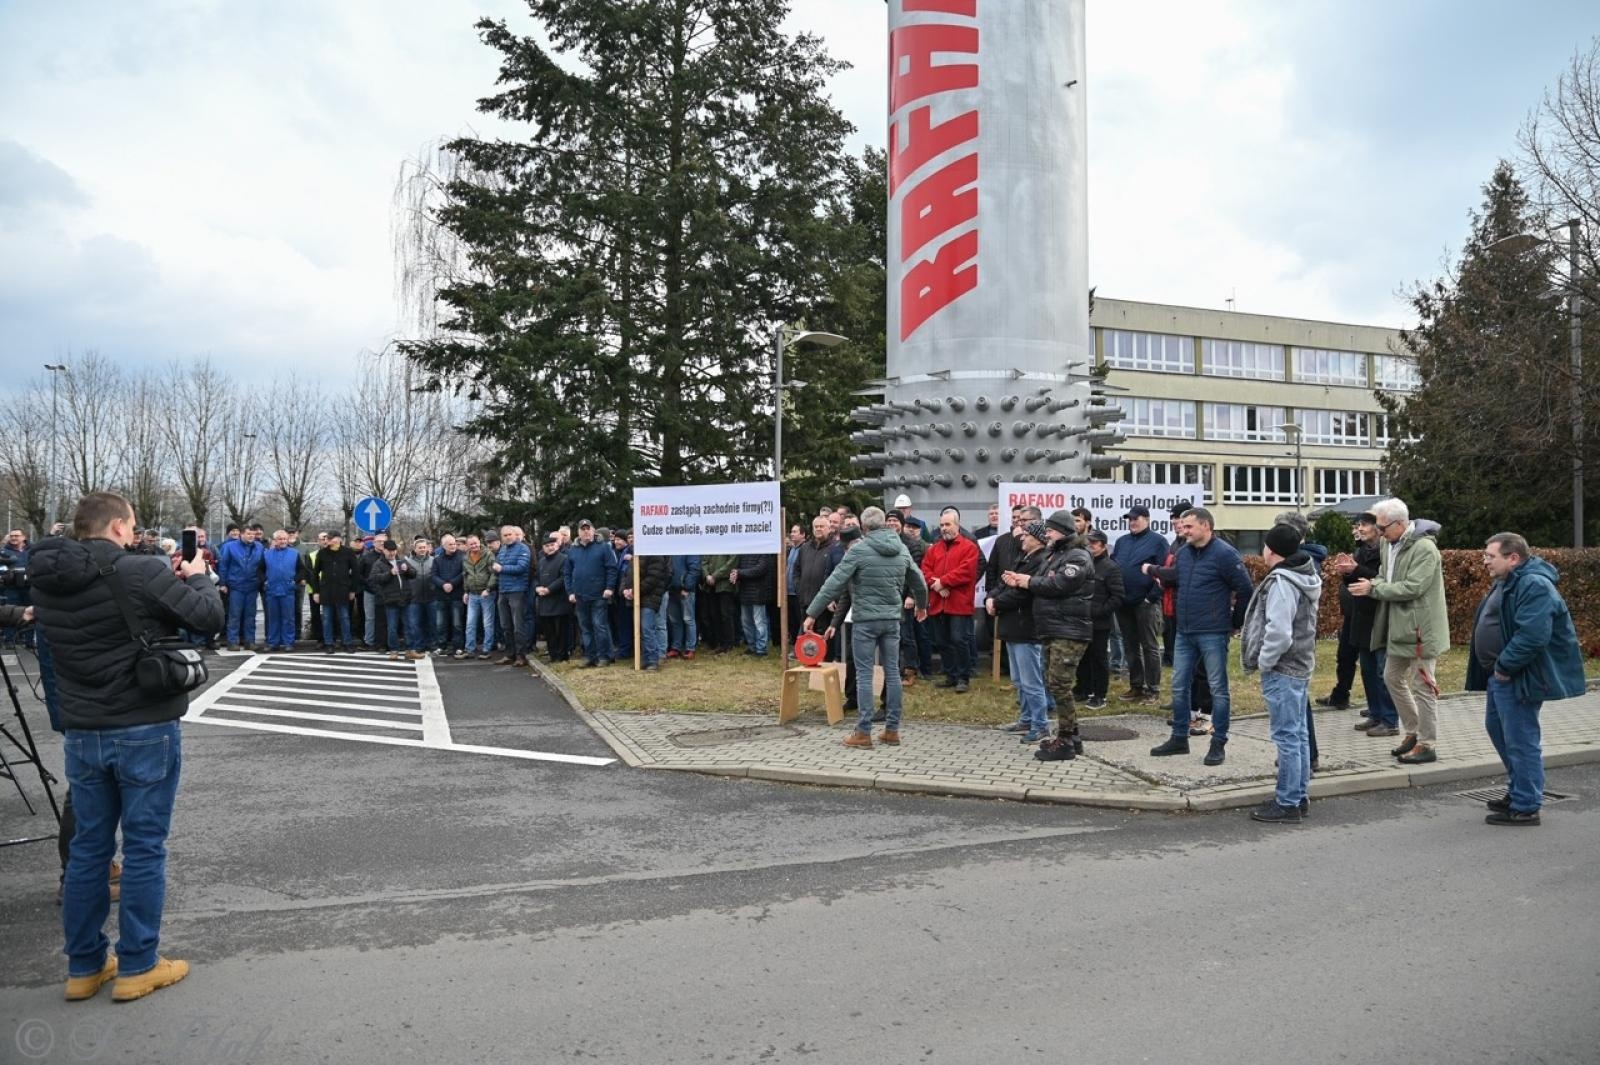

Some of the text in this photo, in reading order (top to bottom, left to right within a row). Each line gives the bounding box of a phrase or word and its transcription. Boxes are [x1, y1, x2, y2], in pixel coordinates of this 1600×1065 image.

[889, 0, 980, 342] RAFA
[640, 500, 774, 518] RAFAKO zastąpią zachodnie firmy(?!)
[1008, 493, 1065, 508] RAFAKO
[1071, 494, 1085, 509] to
[1091, 494, 1114, 509] nie
[641, 521, 773, 536] Cudze chwalicie, swego nie znacie!
